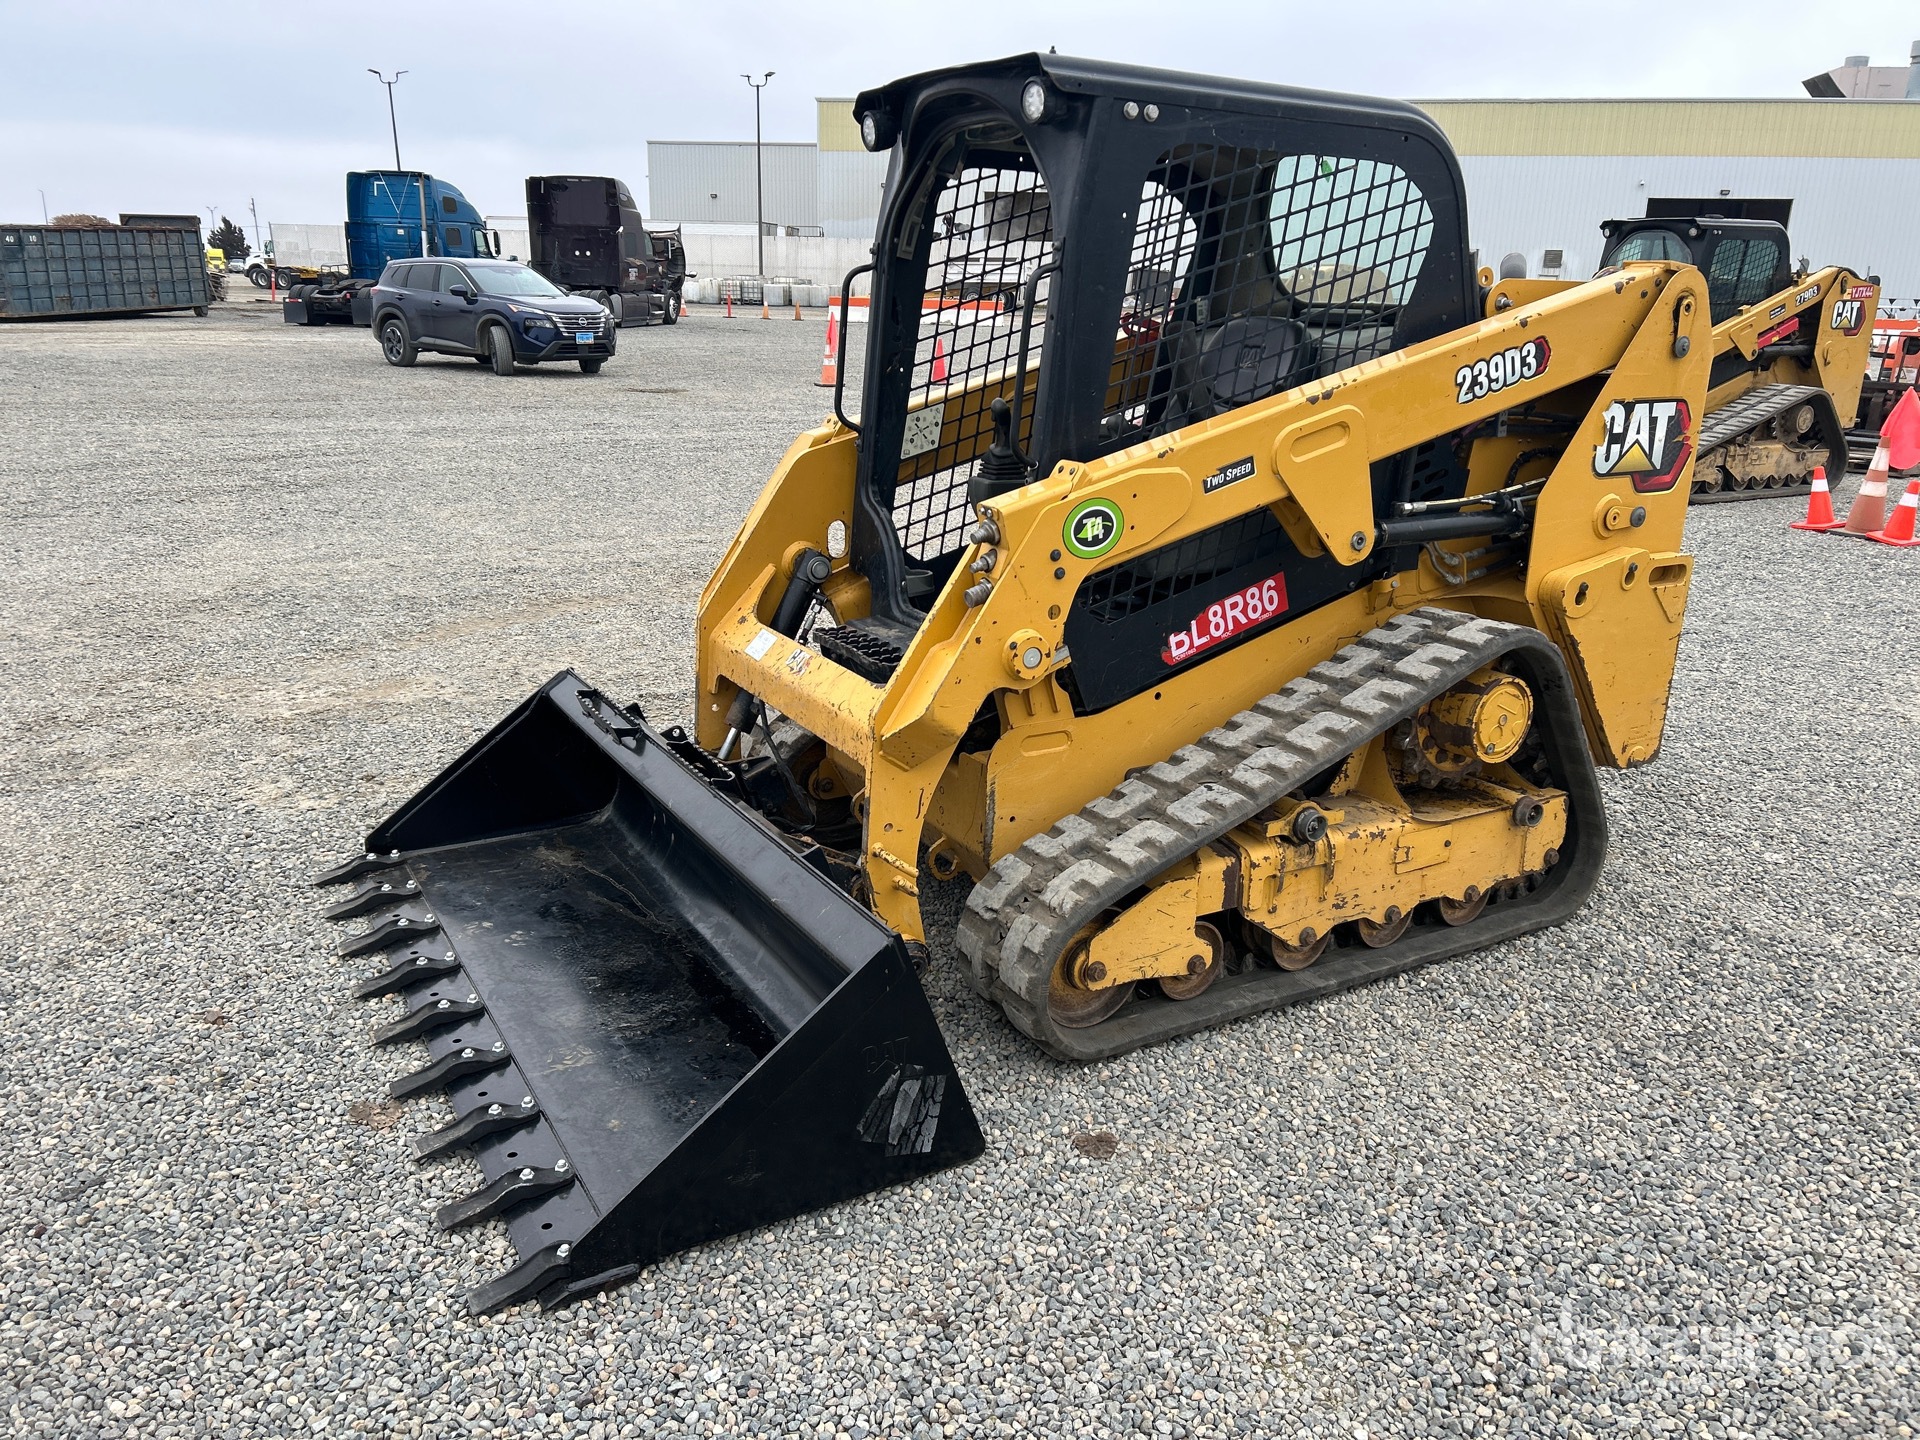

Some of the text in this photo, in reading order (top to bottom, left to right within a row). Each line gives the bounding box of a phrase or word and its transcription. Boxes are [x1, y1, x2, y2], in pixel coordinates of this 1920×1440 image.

[5, 235, 14, 243] 40
[1795, 285, 1818, 306] 279D3
[1832, 300, 1861, 329] CAT
[1456, 341, 1537, 403] 239D3
[1594, 402, 1677, 475] CAT
[1226, 462, 1252, 481] SPEED
[1168, 579, 1279, 658] BL8R86
